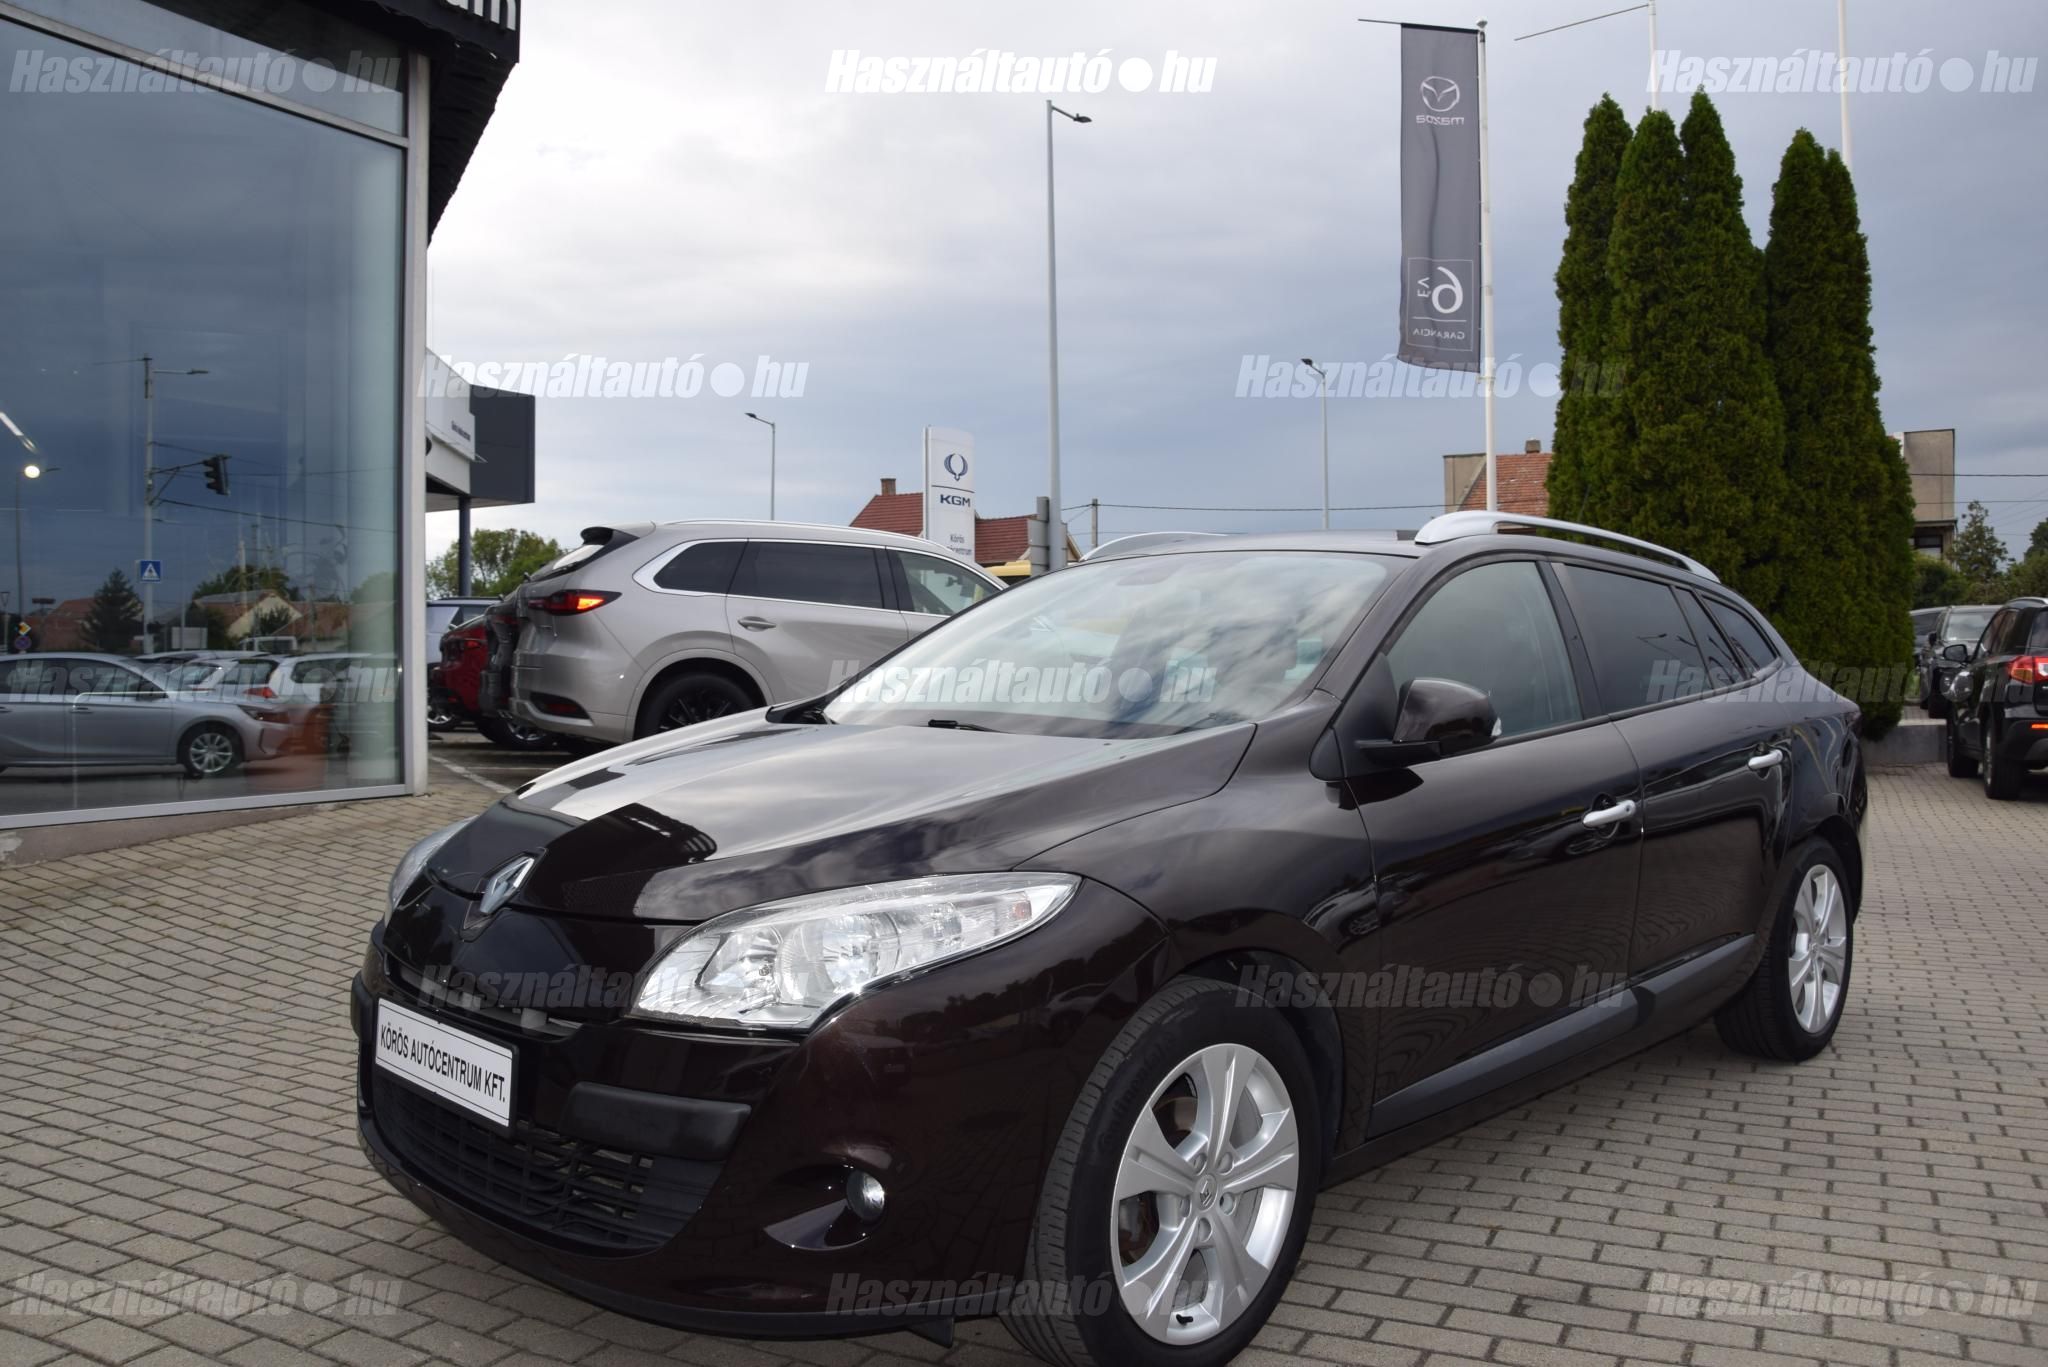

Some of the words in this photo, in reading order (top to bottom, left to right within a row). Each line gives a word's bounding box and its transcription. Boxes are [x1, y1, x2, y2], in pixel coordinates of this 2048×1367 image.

[940, 494, 971, 507] KGM
[411, 1039, 482, 1091] AUTÓCENTRUM
[485, 1070, 505, 1102] KFT.
